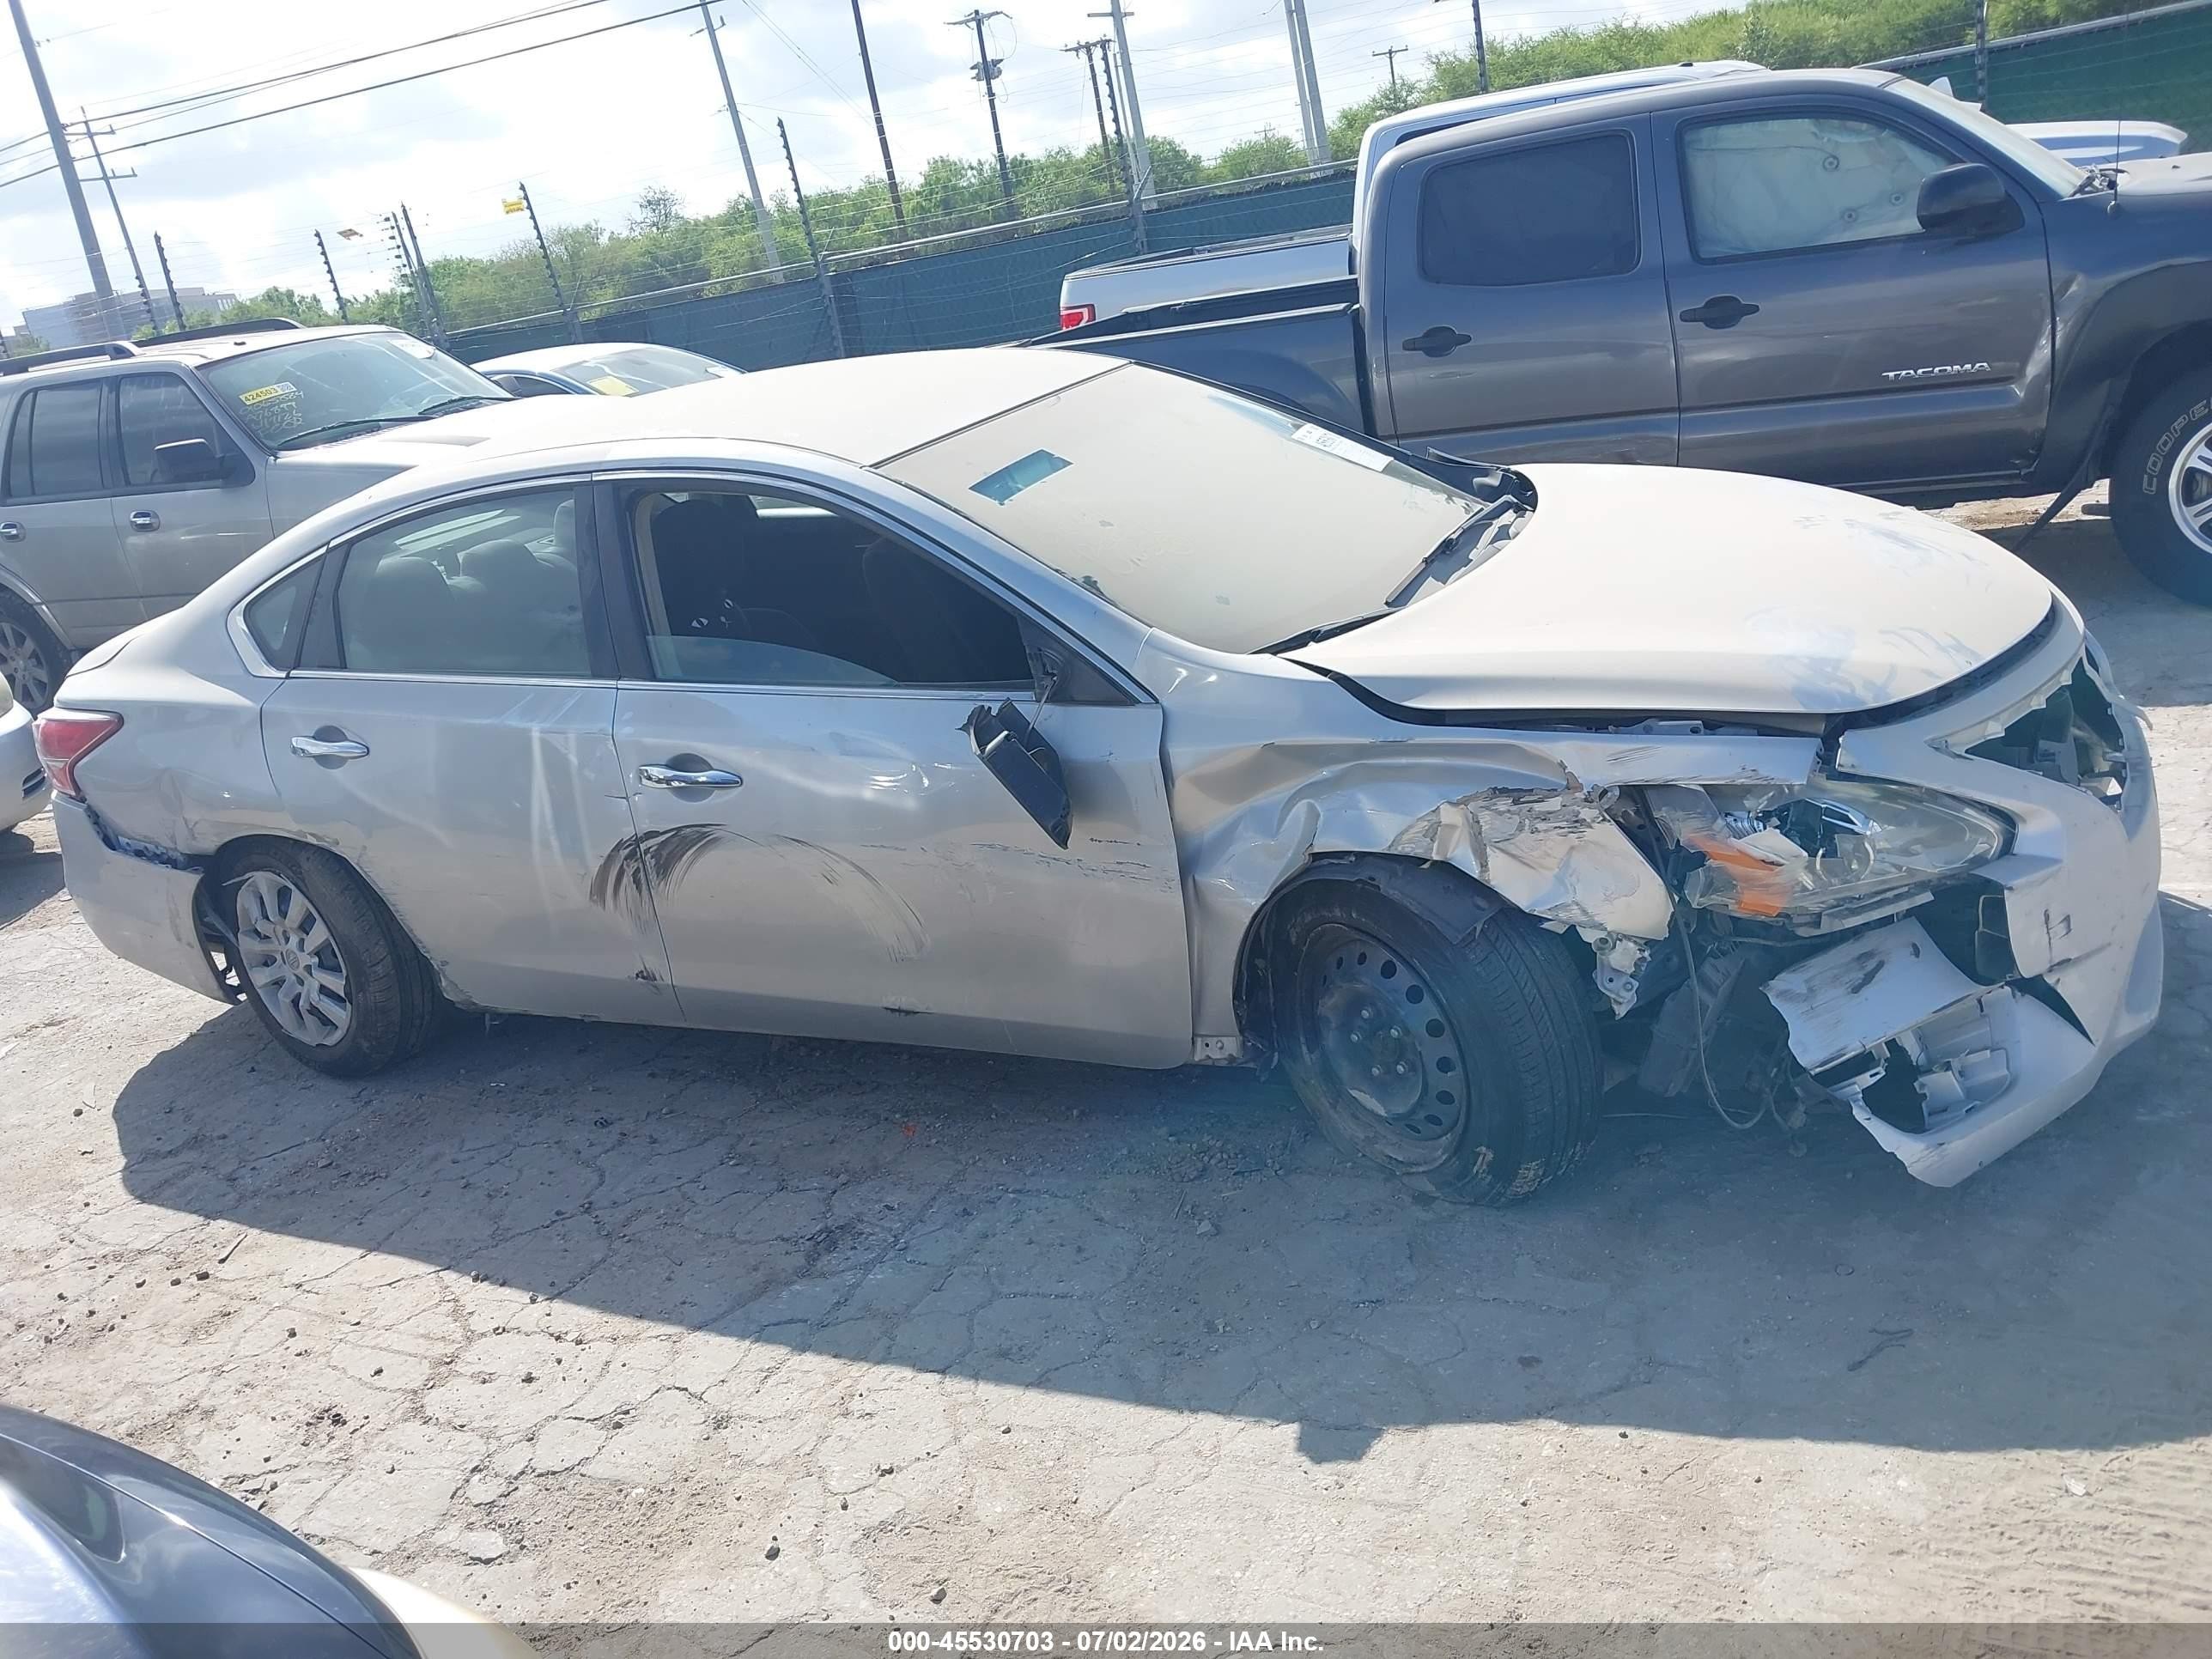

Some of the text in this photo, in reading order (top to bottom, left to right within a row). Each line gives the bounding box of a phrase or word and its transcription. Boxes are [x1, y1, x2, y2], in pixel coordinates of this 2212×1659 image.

[1881, 362, 1991, 381] TACOMA
[244, 387, 279, 402] 424503
[2142, 397, 2212, 495] COOPE
